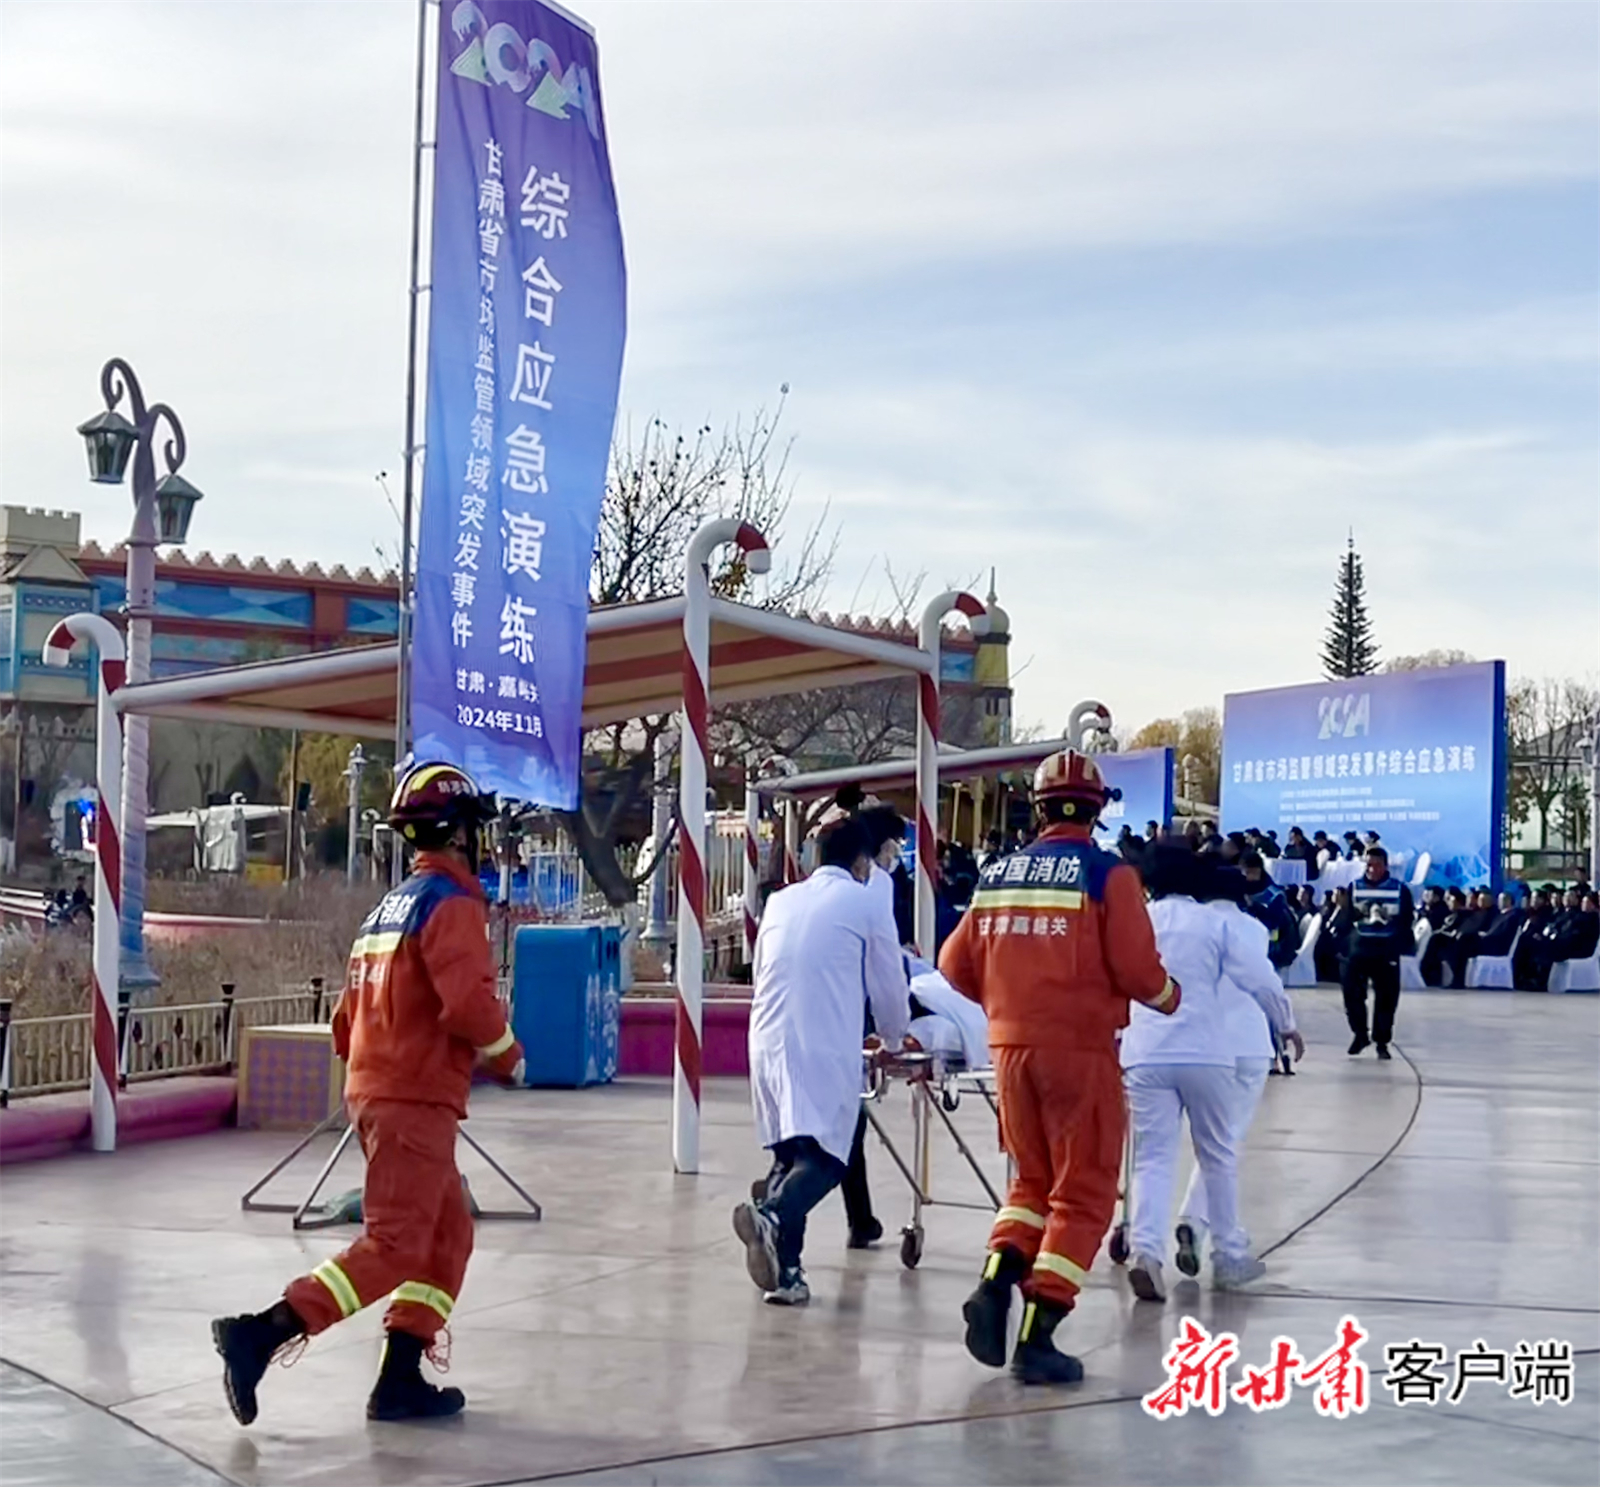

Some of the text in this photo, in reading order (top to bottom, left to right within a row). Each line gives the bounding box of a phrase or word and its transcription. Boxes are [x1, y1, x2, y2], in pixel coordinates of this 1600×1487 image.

[499, 164, 571, 664] 综合应急演练
[983, 855, 1082, 884] 中国消防
